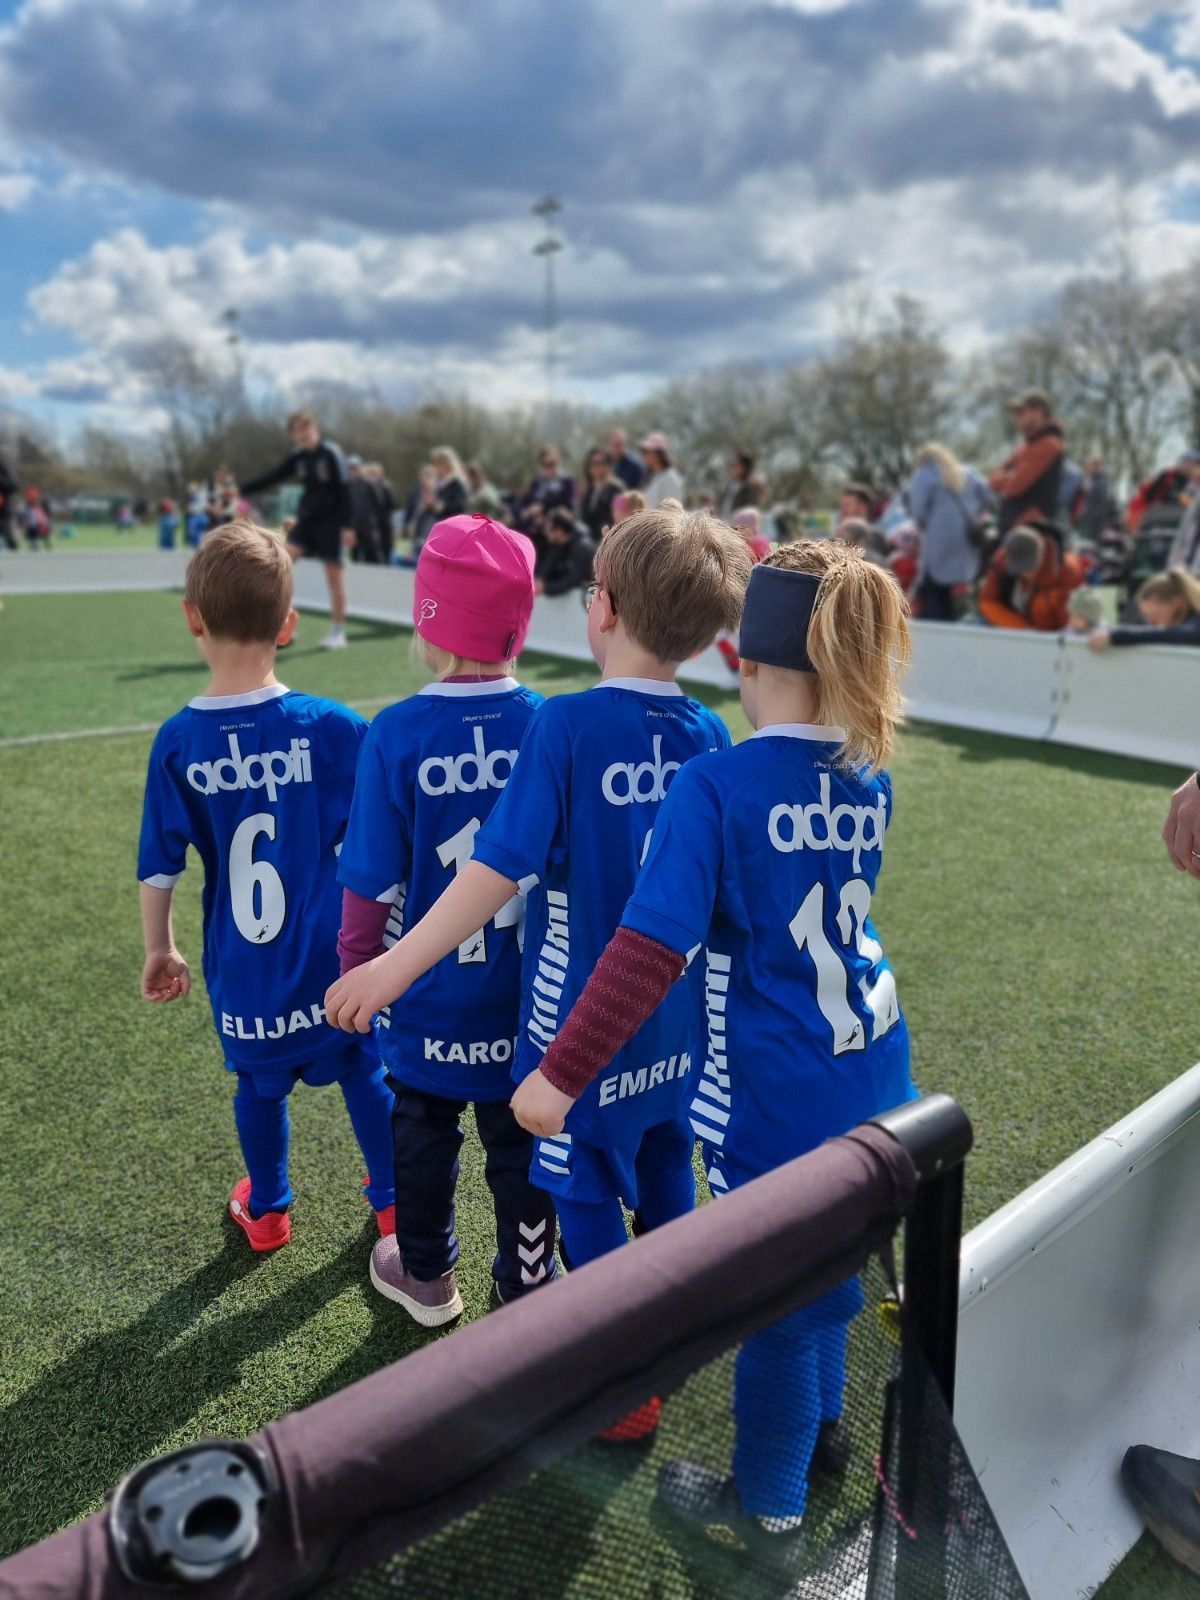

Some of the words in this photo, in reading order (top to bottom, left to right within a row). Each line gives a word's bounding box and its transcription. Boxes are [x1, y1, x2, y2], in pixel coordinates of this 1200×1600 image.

[186, 733, 313, 802] adapti
[418, 726, 519, 796] ada
[229, 812, 286, 944] 6
[788, 879, 900, 1056] 12
[222, 1003, 327, 1040] ELIJAH
[424, 1036, 517, 1065] KARO
[599, 1052, 691, 1107] EMRIK
